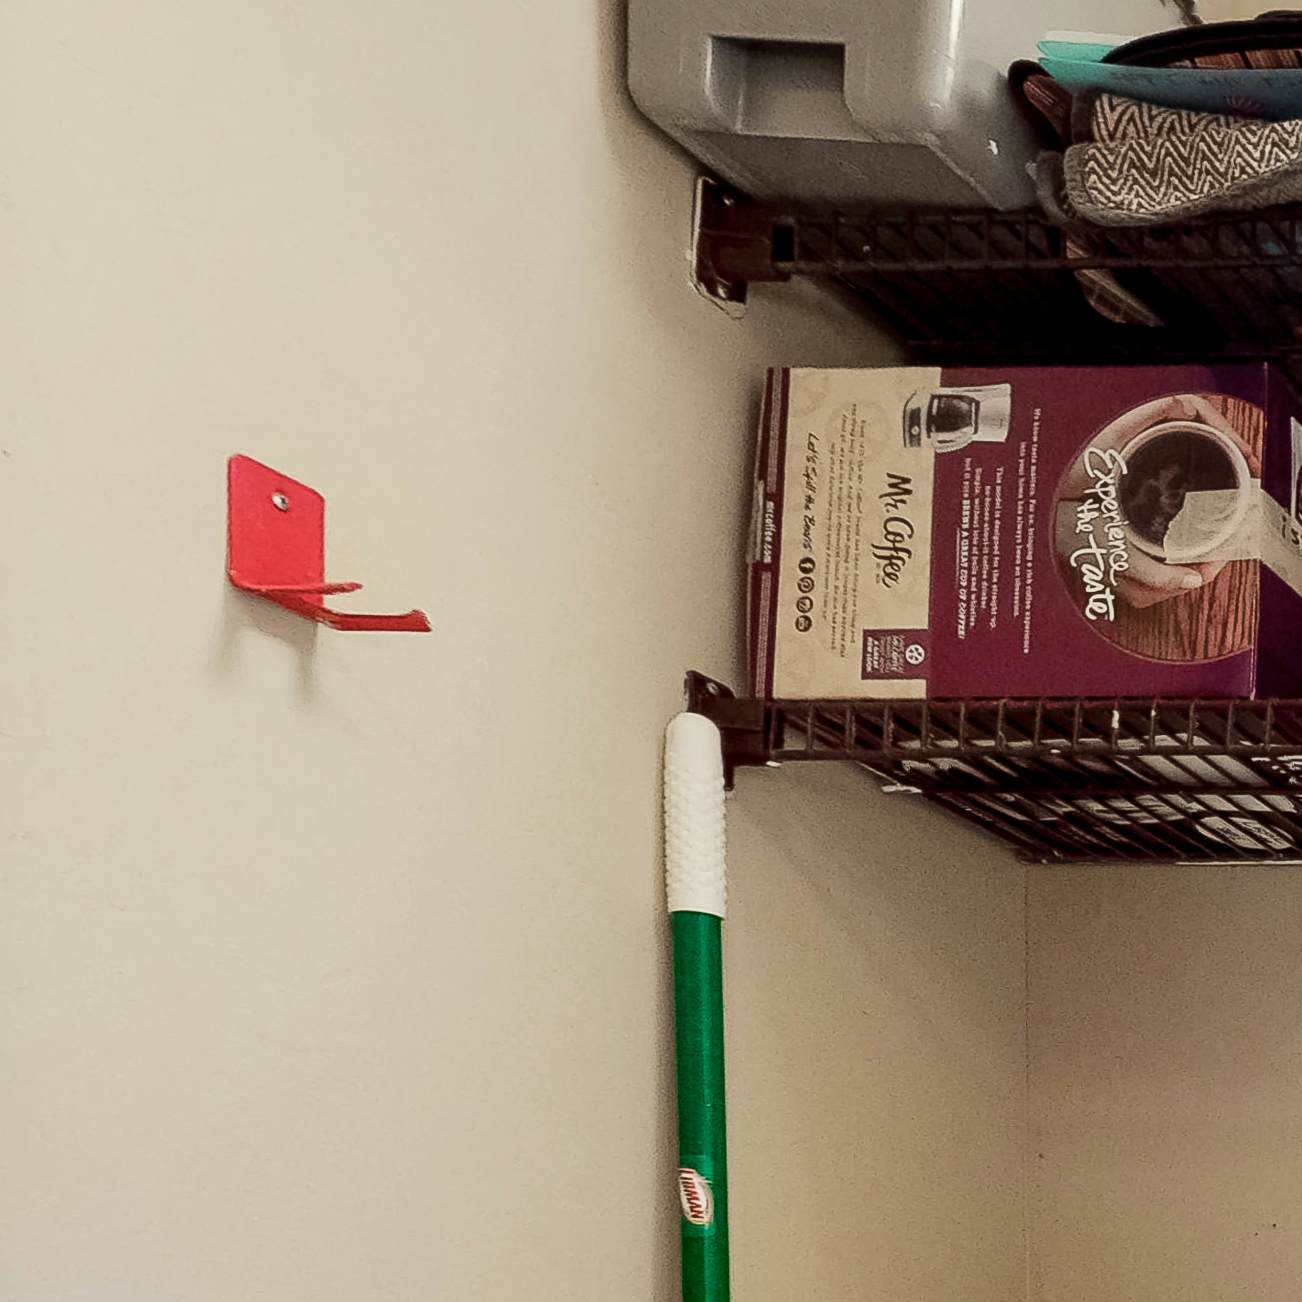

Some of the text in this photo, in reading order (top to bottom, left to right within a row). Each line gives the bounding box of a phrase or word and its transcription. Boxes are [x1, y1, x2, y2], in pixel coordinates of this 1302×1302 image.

[964, 457, 972, 472] but
[1031, 443, 1039, 463] taste
[996, 466, 1004, 484] This
[1017, 477, 1025, 499] home
[802, 432, 820, 551] Let's Spill the Beans
[879, 472, 914, 514] Mr.
[995, 485, 1004, 509] model
[961, 500, 970, 529] BREWS
[972, 498, 981, 528] without
[1016, 500, 1024, 515] has
[1083, 448, 1129, 586] Experience
[763, 500, 777, 564] mrcoffee.com
[992, 519, 1002, 555] designed
[1014, 515, 1024, 544] always
[1025, 527, 1036, 561] bringing
[871, 516, 915, 588] Coffee
[959, 538, 968, 568] GREAT
[1014, 545, 1023, 564] been
[1070, 498, 1115, 622] the taste
[958, 568, 968, 587] CUP
[1025, 568, 1034, 584] rich
[1024, 586, 1034, 610] coffee
[1022, 611, 1032, 654] experience
